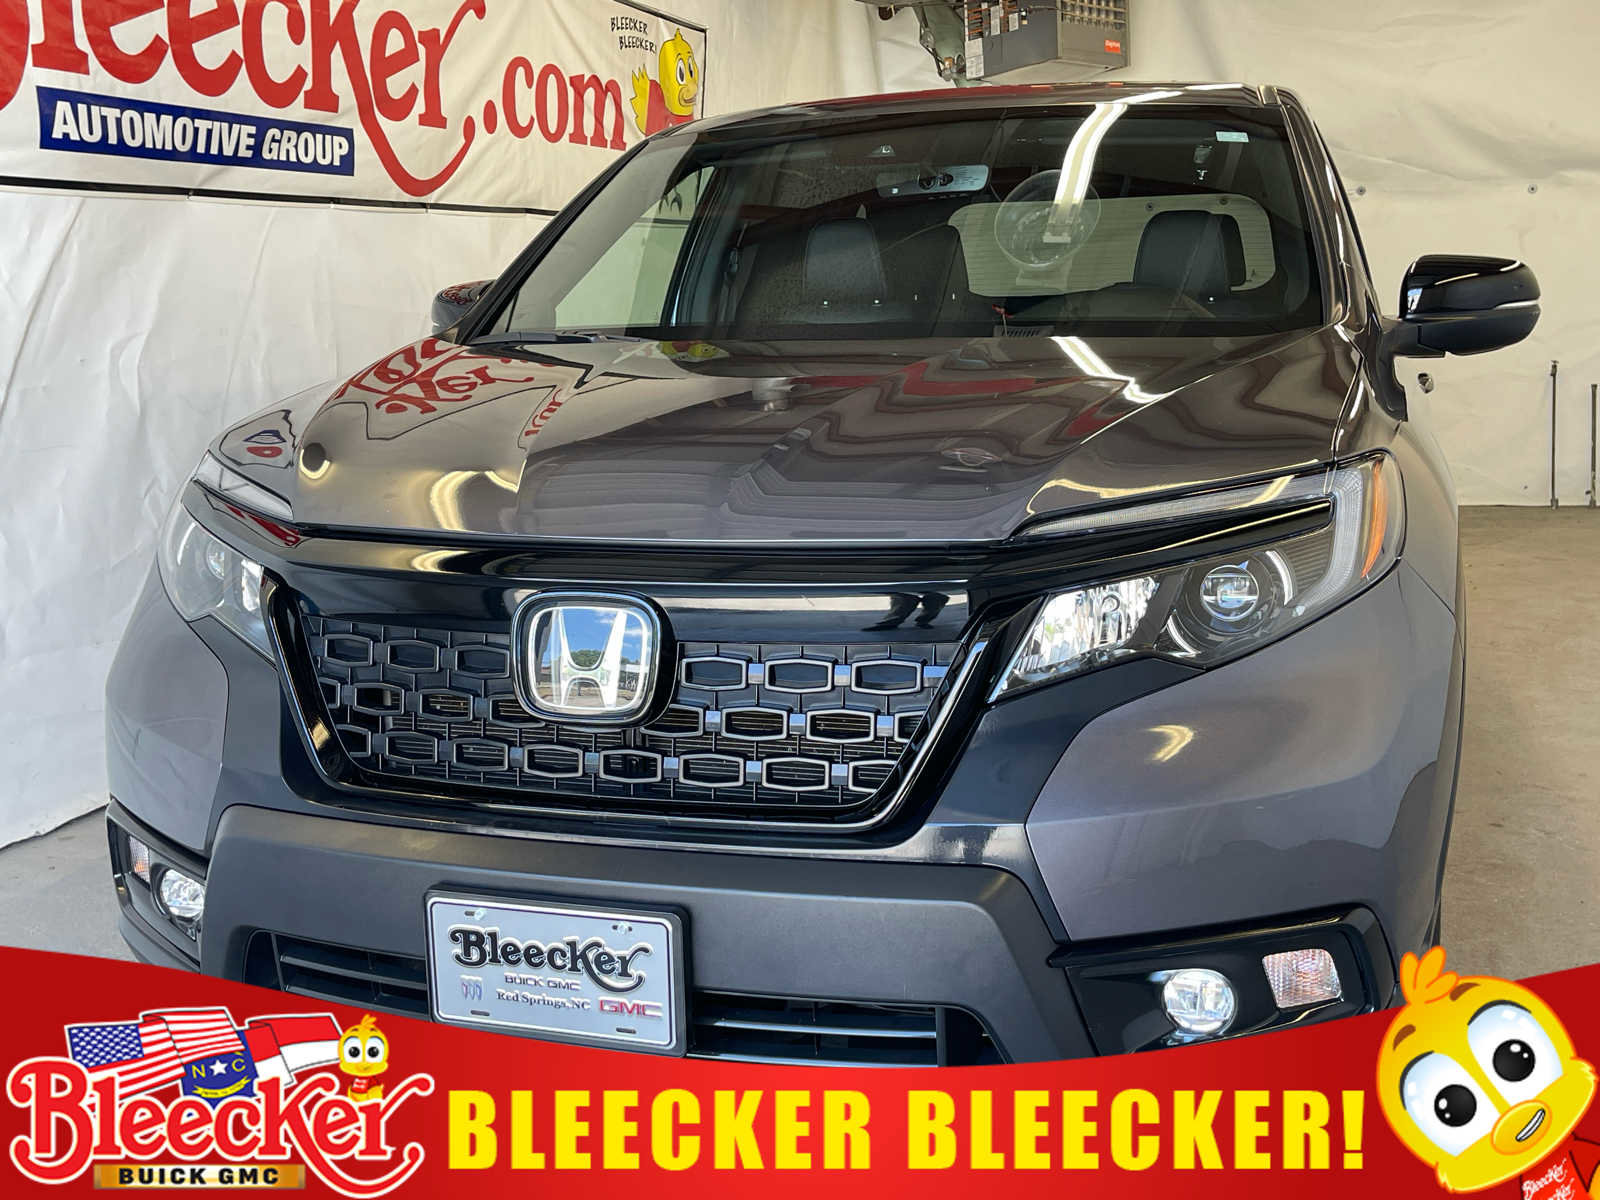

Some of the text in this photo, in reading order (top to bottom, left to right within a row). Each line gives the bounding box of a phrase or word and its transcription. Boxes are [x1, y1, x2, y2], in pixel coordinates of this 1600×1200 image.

[611, 16, 648, 35] BLEECKER
[619, 36, 657, 54] BLEECKER!
[0, 0, 626, 198] eecker.com
[52, 100, 350, 167] AUTOMOTIVE GROUP
[504, 974, 582, 992] BUICK GMC
[496, 990, 520, 1003] Red
[571, 998, 591, 1011] NC
[599, 998, 663, 1019] GMC
